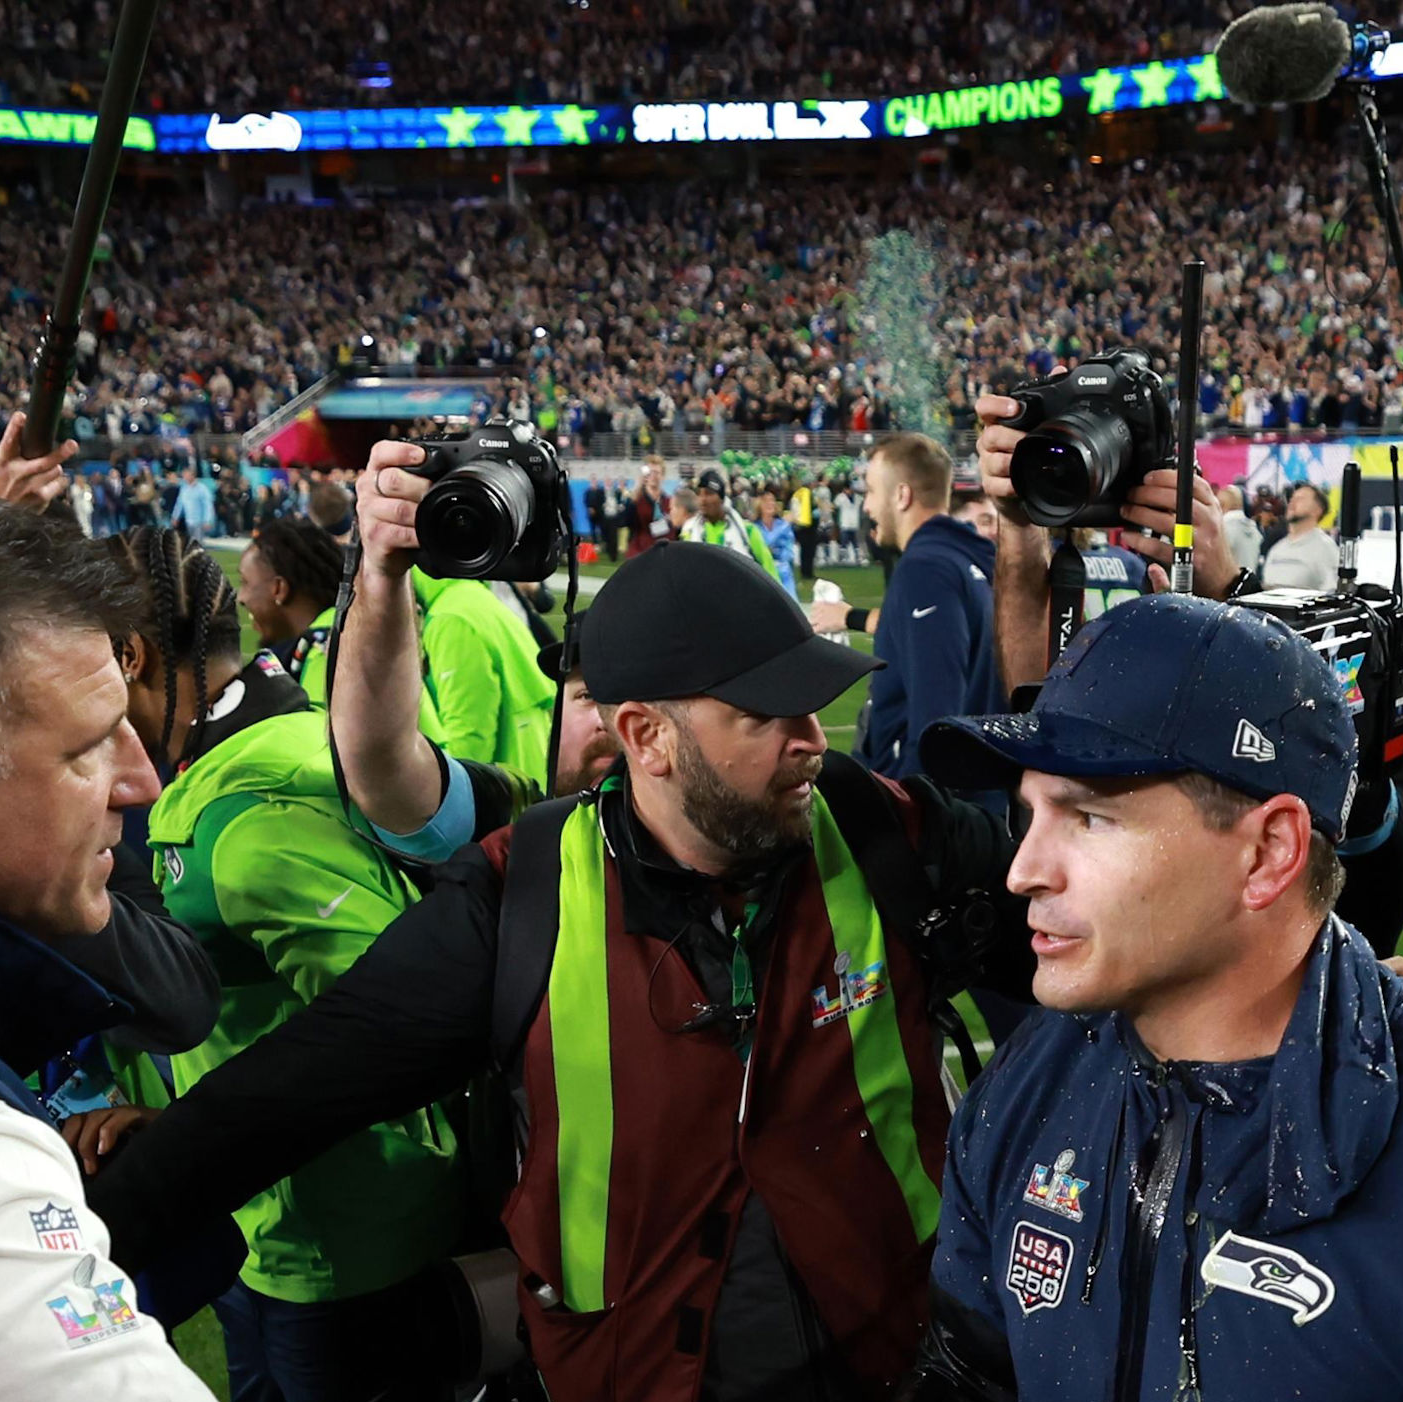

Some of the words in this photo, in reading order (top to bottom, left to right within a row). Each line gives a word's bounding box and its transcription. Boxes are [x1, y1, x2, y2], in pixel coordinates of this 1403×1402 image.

[632, 104, 706, 142] SUPER
[707, 102, 774, 140] BOWL
[773, 100, 872, 139] LX
[1077, 376, 1108, 386] Canon
[479, 438, 510, 449] Canon
[1019, 1232, 1064, 1267] USA
[1009, 1264, 1061, 1302] 250
